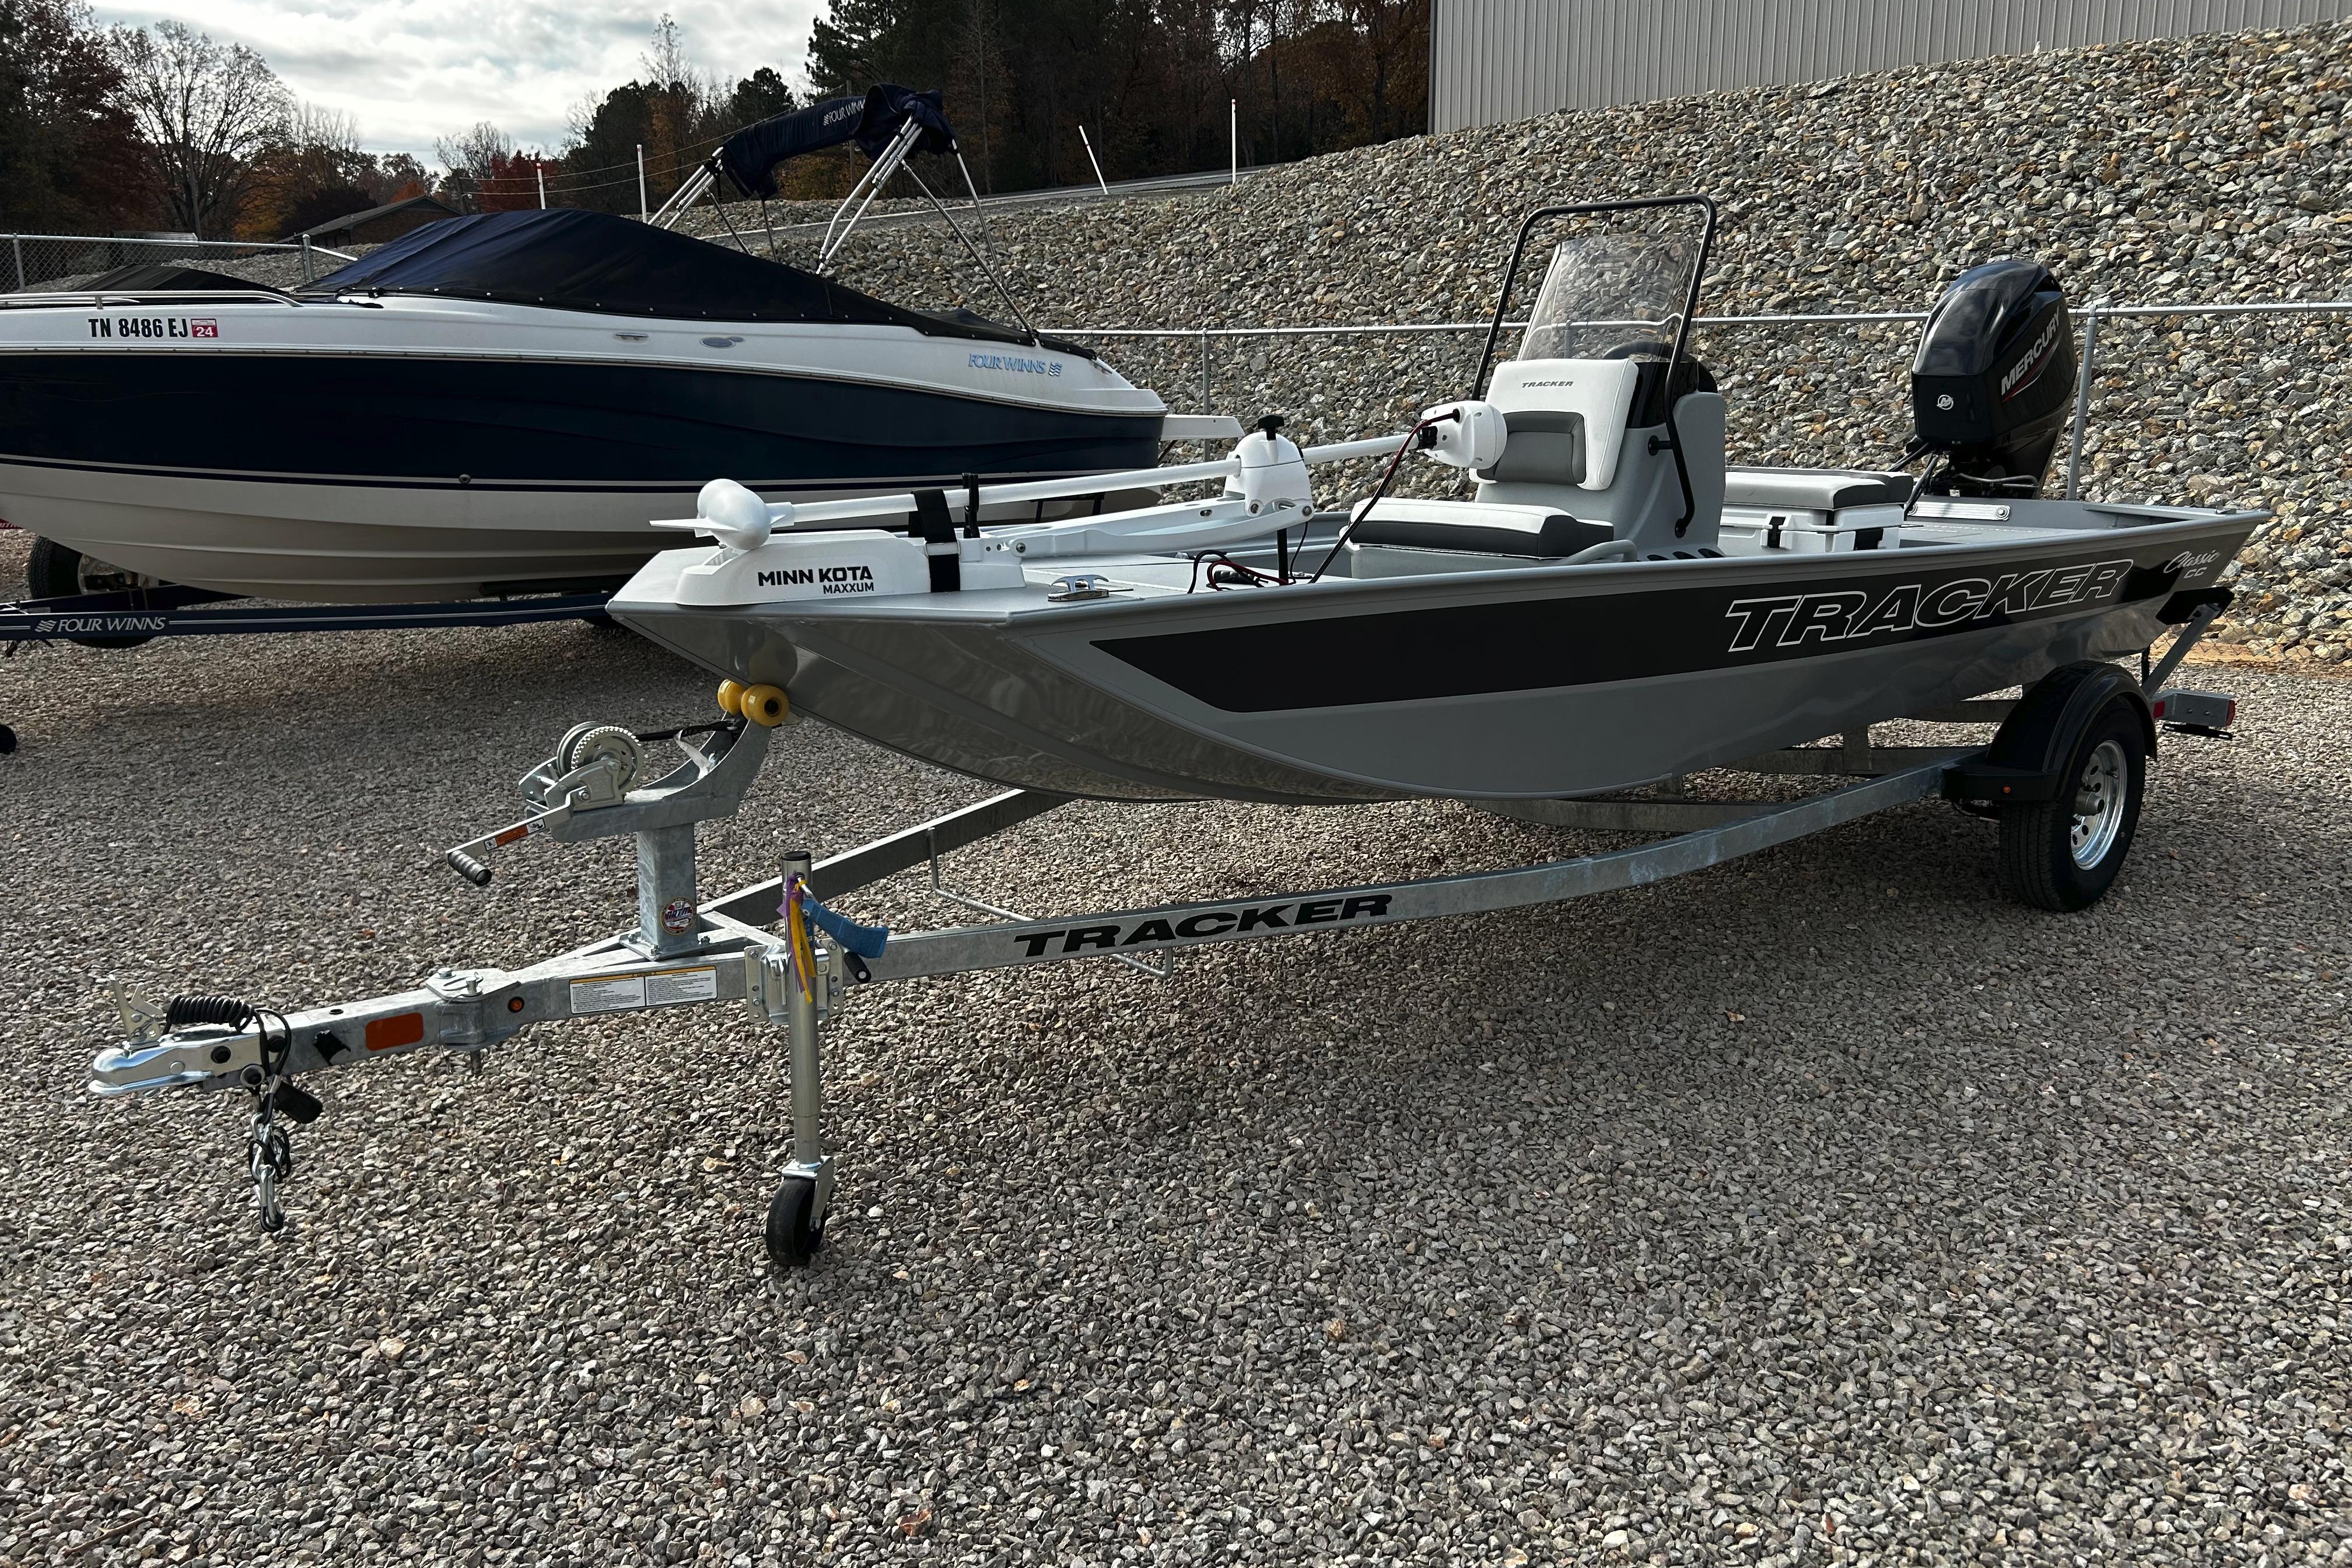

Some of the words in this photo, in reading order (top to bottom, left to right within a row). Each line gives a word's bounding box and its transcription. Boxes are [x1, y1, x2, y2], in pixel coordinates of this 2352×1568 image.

[828, 107, 846, 124] FOUR
[88, 318, 111, 338] TN
[118, 318, 163, 338] 8486
[167, 318, 188, 338] EJ
[196, 326, 214, 337] 24
[2001, 305, 2059, 396] MERCURY
[968, 354, 1002, 370] FOUR
[1003, 357, 1045, 374] WINNS
[2163, 550, 2221, 573] Classic
[758, 569, 814, 587] MINN
[818, 566, 873, 583] KOTA
[2183, 566, 2207, 579] CC
[823, 582, 874, 594] MAXXUM
[1725, 558, 2134, 652] TRACKER
[57, 618, 102, 632] FOUR
[106, 617, 166, 631] WINNS
[1013, 894, 1392, 958] TRACKER
